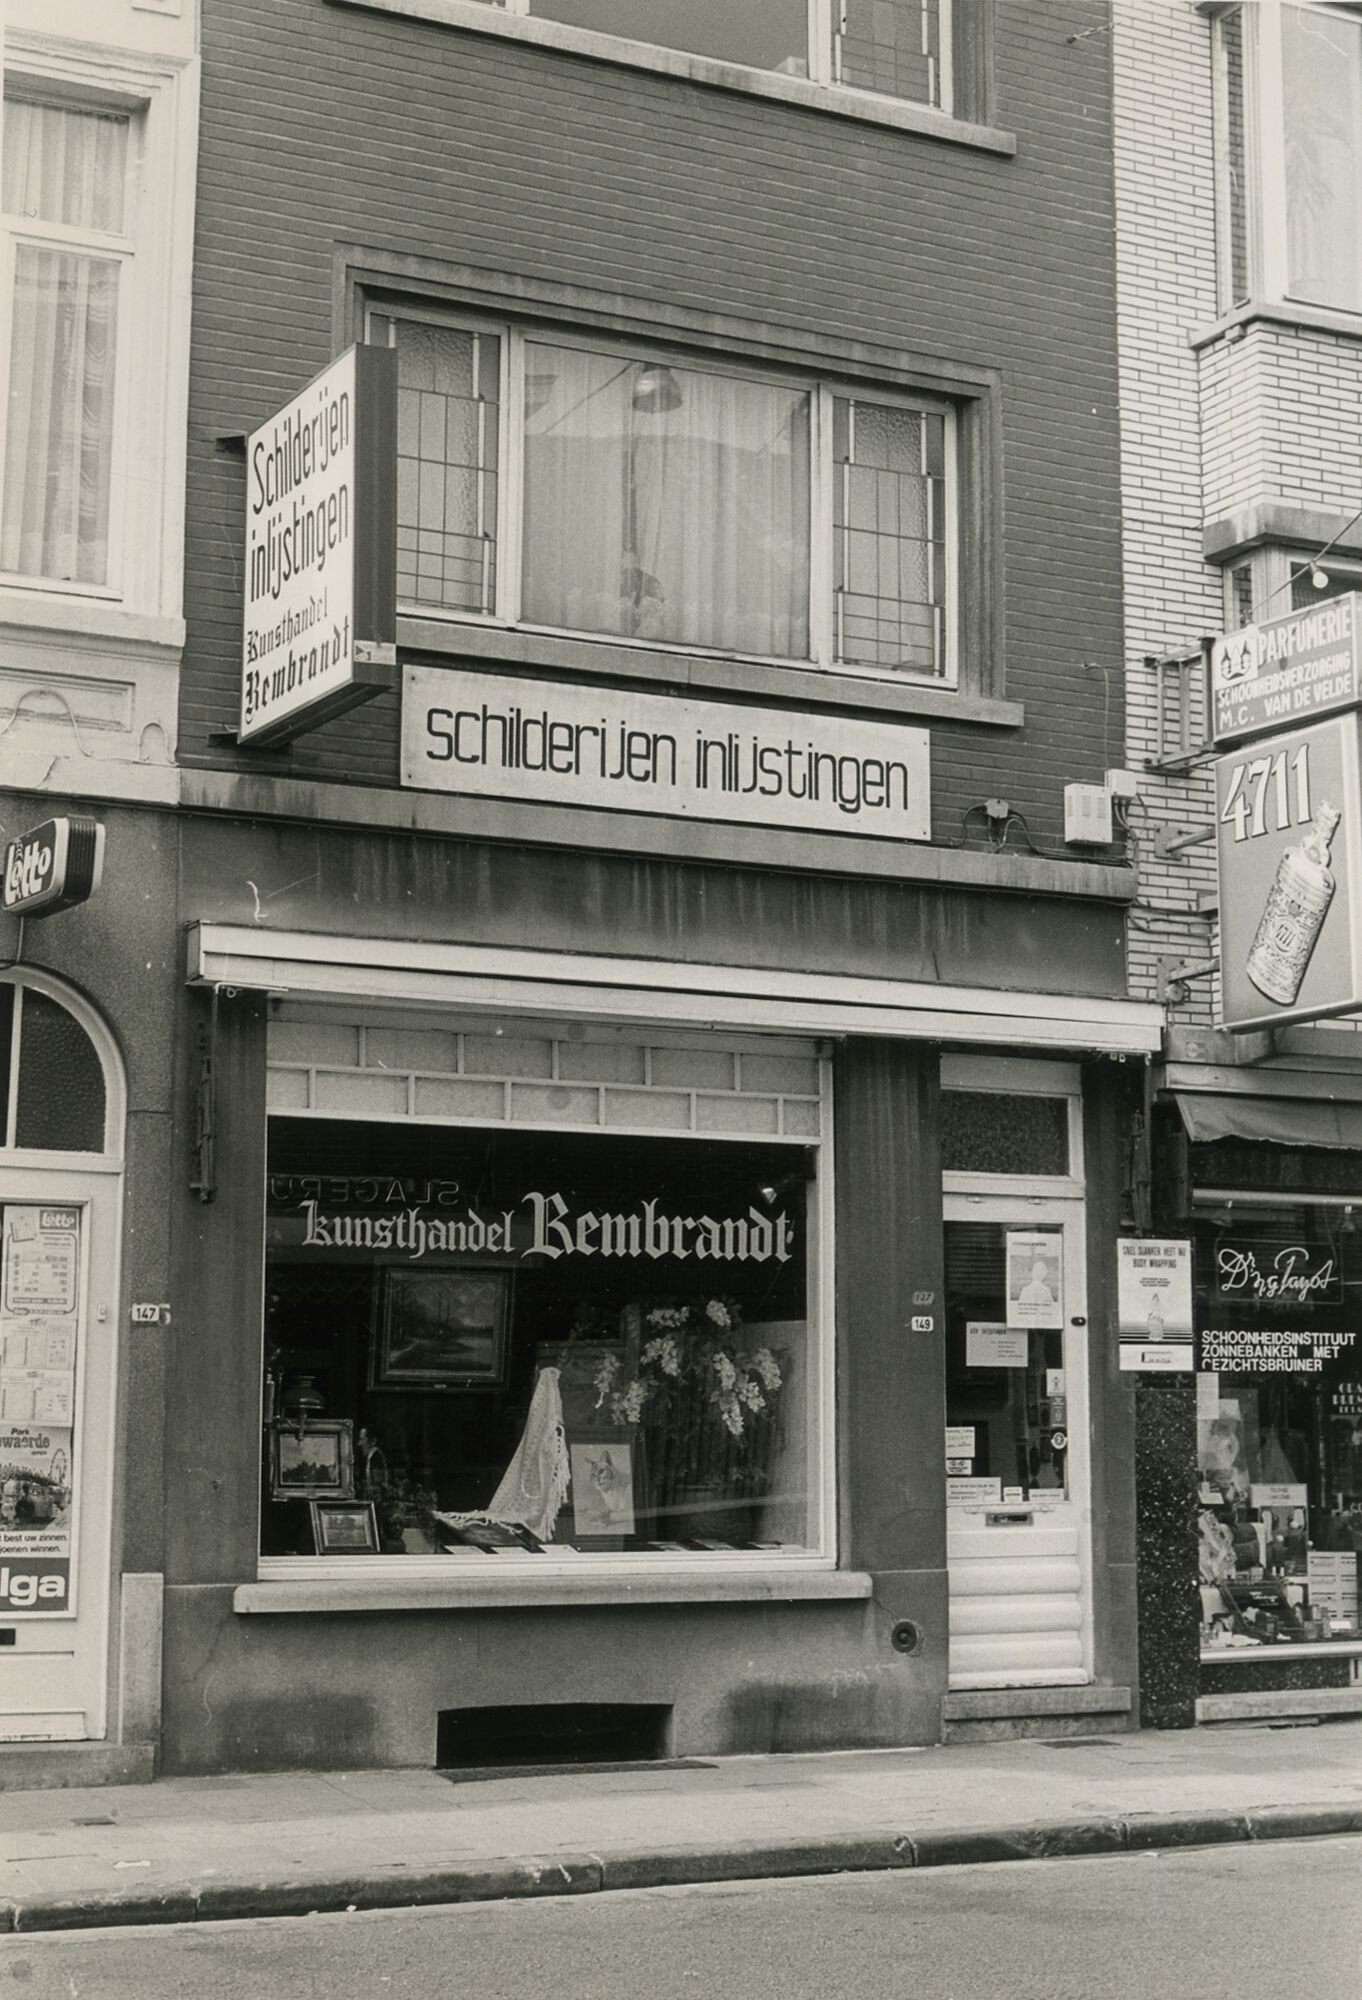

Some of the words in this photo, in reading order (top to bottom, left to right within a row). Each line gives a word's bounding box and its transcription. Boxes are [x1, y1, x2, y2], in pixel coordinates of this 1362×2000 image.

[253, 386, 349, 515] Schilderijen
[251, 484, 348, 602] inlijstingen
[1258, 604, 1351, 666] PARFUMERIE
[245, 616, 349, 725] Rembrandt
[1220, 705, 1255, 731] M.C.
[1264, 691, 1291, 717] VAN
[1294, 685, 1311, 708] DE
[1313, 673, 1352, 703] VELDE
[427, 704, 676, 785] schilderijen
[697, 730, 908, 814] inlijstingen
[1220, 743, 1312, 843] 4711
[5, 840, 51, 905] Lotto
[521, 1192, 793, 1263] Rembrandt
[1133, 1258, 1147, 1268] BODY
[1149, 1259, 1177, 1269] WRAPPING
[136, 1307, 156, 1320] 147
[914, 1318, 931, 1330] 149
[1202, 1330, 1356, 1346] SCHOONHEIDSINSTITUUT
[1202, 1344, 1298, 1358] ZONNEBANKEN
[1313, 1346, 1340, 1359] MET
[0, 1433, 50, 1449] waerde
[11, 1427, 30, 1436] Park
[4, 1534, 22, 1543] best
[24, 1535, 37, 1543] uw
